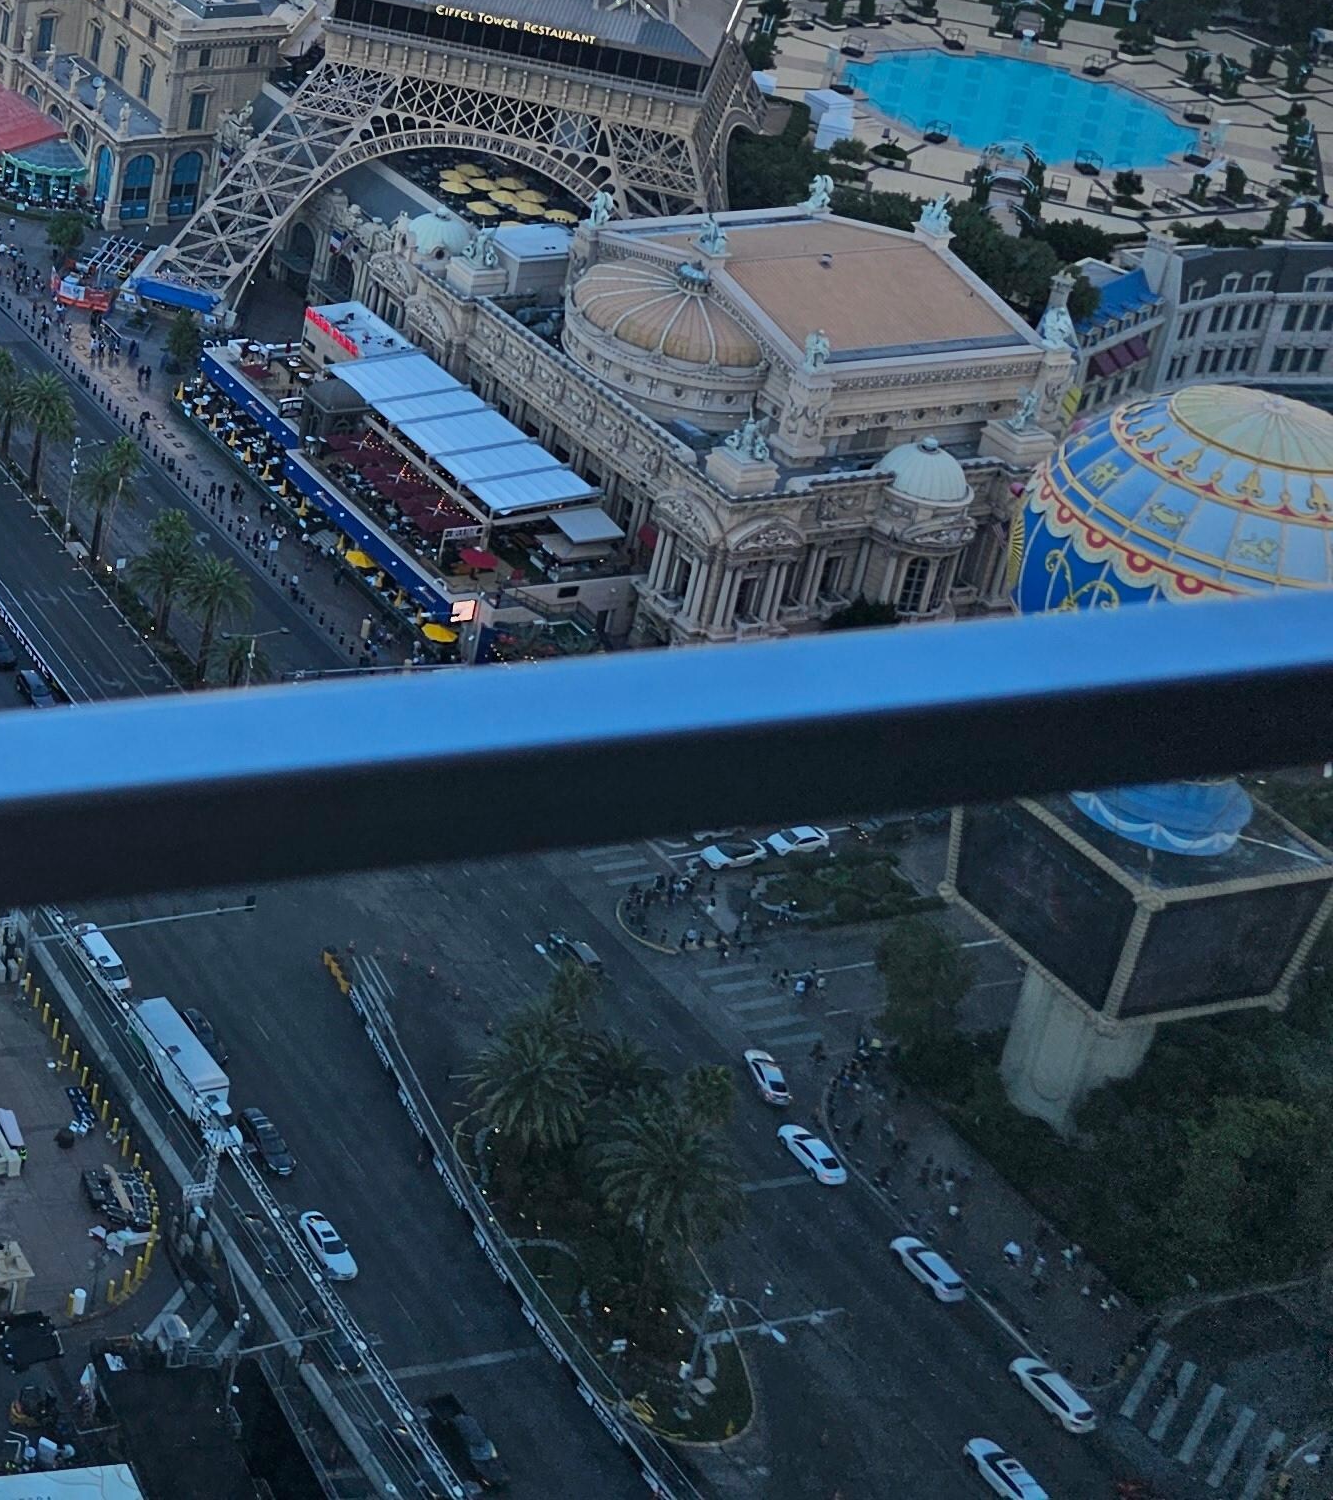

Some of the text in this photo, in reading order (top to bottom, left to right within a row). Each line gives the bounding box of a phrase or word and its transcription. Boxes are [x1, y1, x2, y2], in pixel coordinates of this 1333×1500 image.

[435, 4, 597, 45] EIFFEL TOWER RESTAURANT
